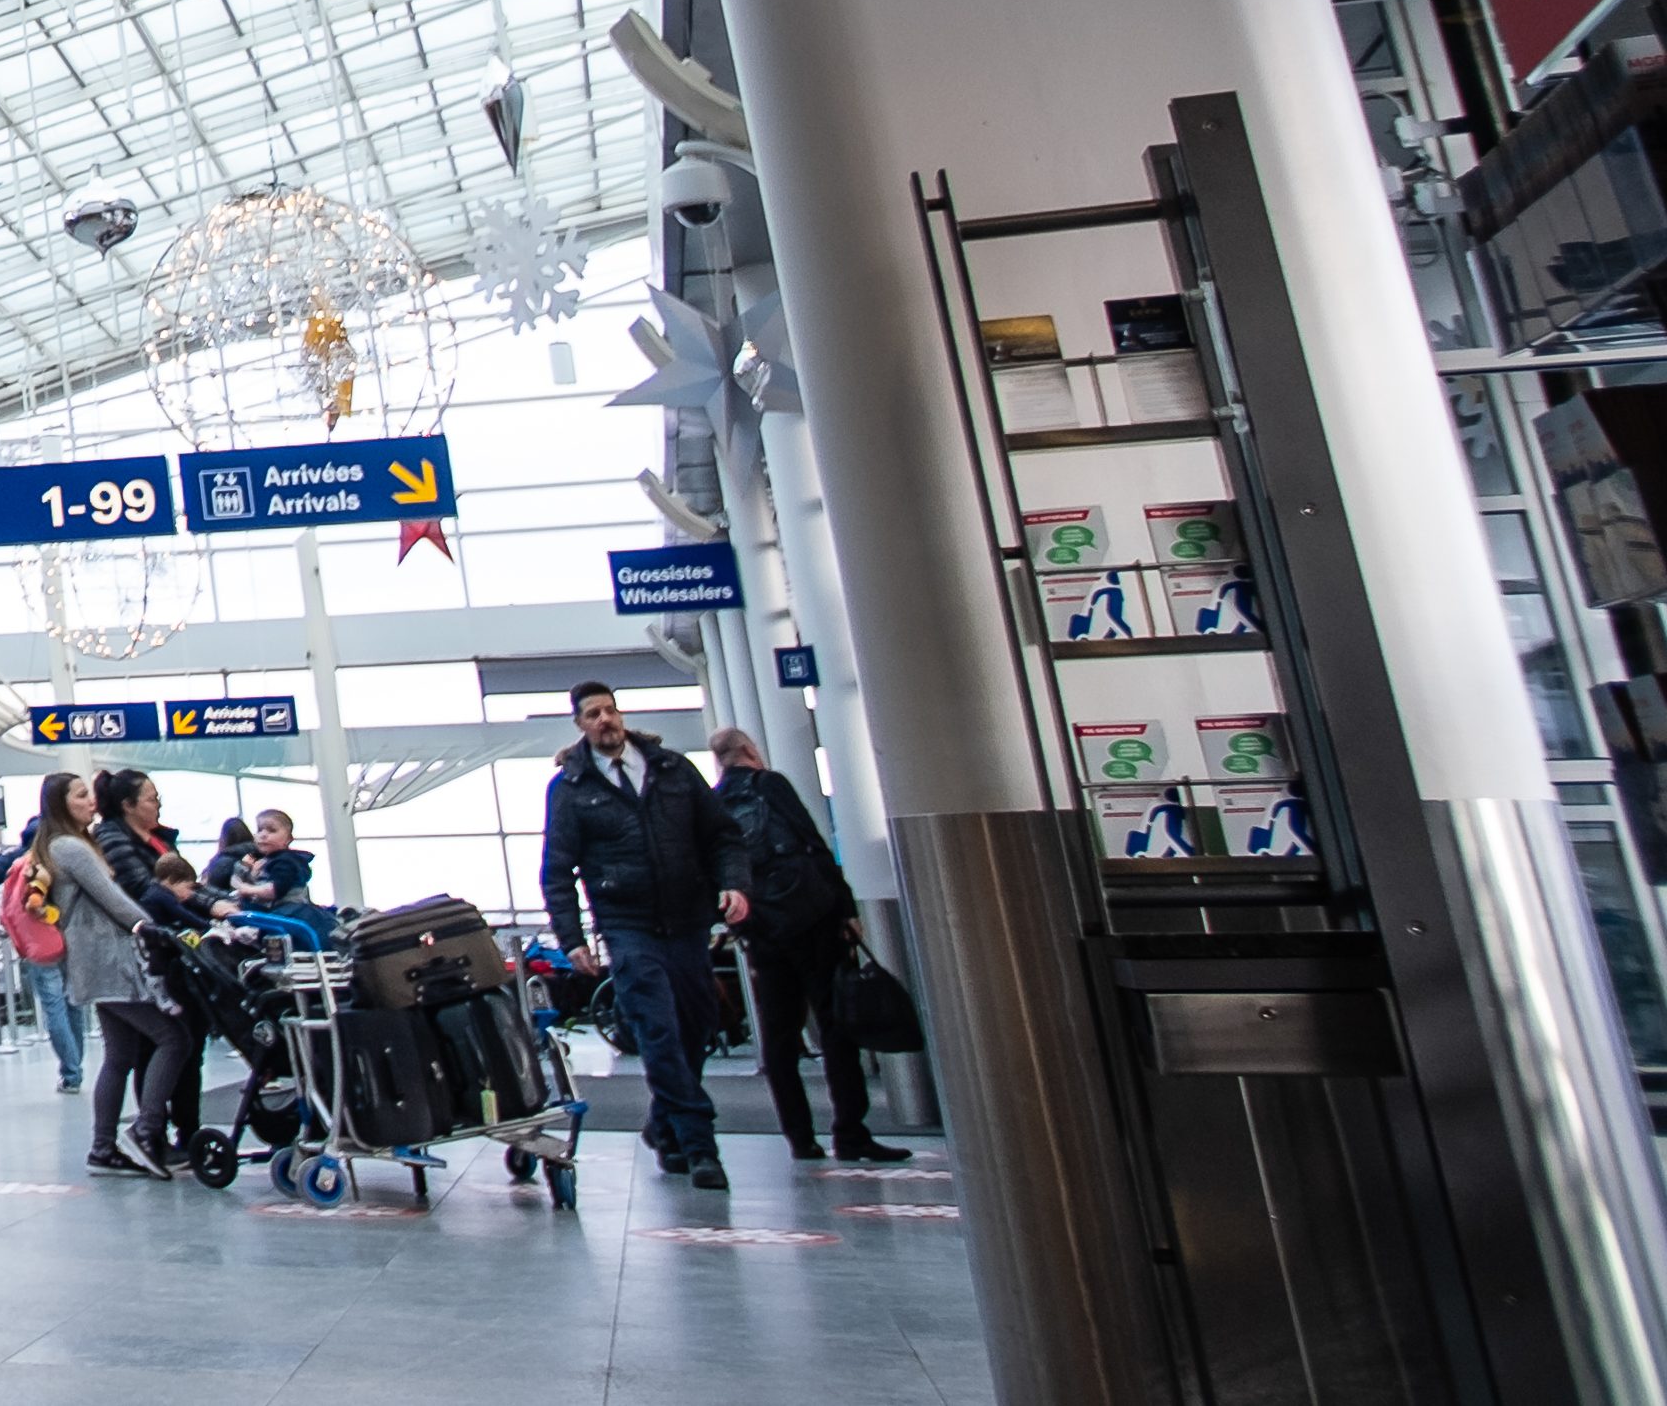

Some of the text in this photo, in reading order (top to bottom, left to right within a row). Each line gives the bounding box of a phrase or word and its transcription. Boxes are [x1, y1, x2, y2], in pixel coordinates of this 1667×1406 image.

[264, 460, 364, 488] Arrivées
[40, 479, 157, 528] 1-99
[269, 487, 361, 516] Arrivals
[617, 564, 714, 585] Grossistes
[620, 584, 734, 605] Wholesalers
